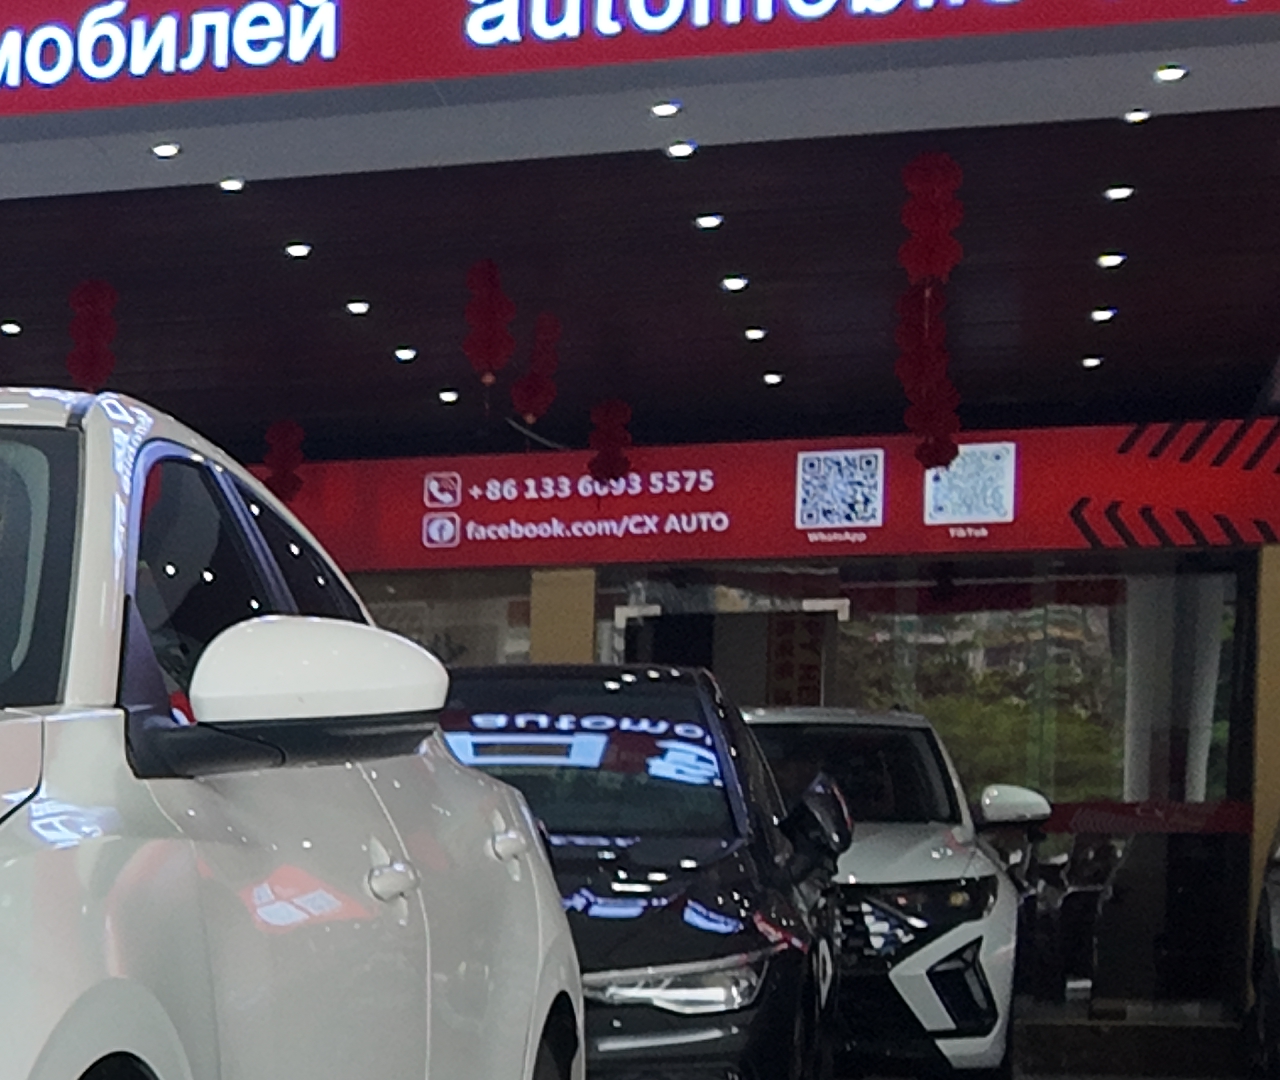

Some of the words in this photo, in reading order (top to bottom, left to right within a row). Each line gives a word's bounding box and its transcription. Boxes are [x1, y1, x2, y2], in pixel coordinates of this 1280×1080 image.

[468, 478, 519, 502] +86
[525, 476, 571, 500] 133
[649, 469, 714, 494] 5575
[466, 514, 658, 540] facebook.com/CX
[665, 511, 730, 533] AUTO
